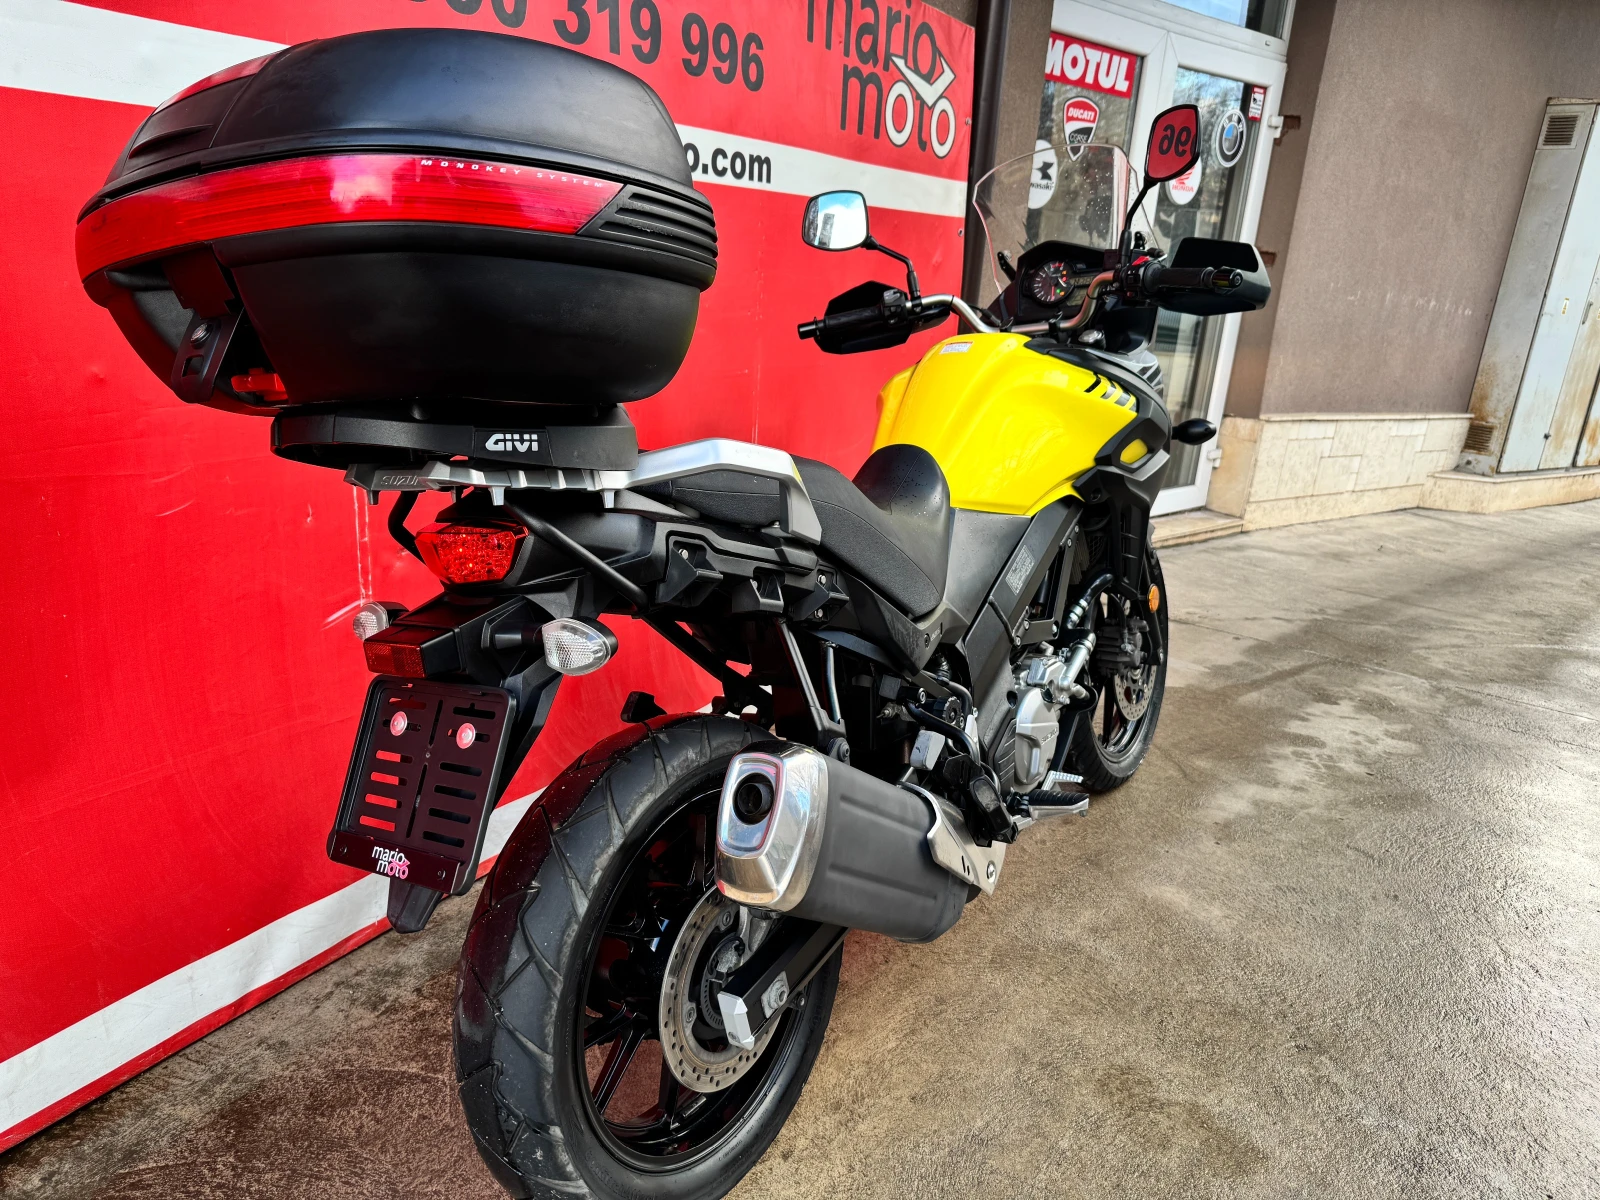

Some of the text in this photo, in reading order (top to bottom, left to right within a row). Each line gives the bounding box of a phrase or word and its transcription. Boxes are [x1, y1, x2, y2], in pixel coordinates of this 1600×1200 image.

[553, 0, 764, 92] 319 996
[807, 0, 937, 83] mario
[1045, 37, 1130, 92] MOTUL
[840, 64, 956, 159] moto
[1067, 107, 1095, 121] DUCATI
[420, 159, 604, 188] MONOKEY SYSTEM
[1172, 184, 1194, 193] HONDA
[485, 433, 539, 452] GIVI
[371, 845, 405, 864] mario
[376, 860, 409, 880] moto
